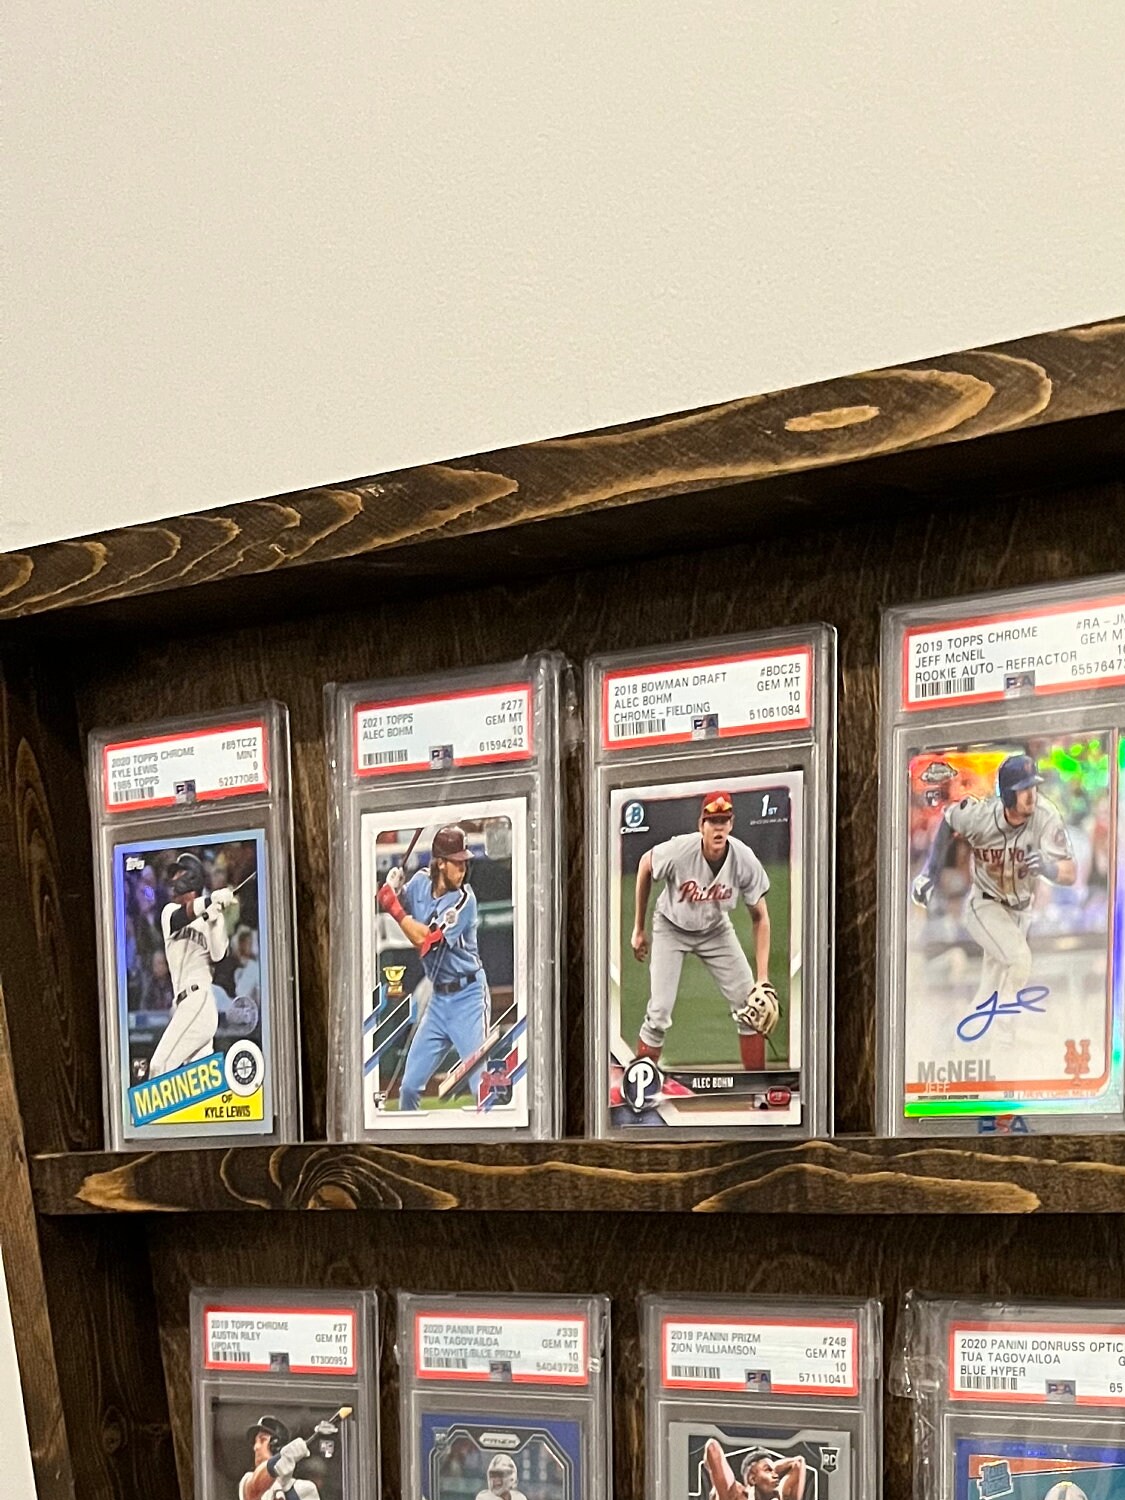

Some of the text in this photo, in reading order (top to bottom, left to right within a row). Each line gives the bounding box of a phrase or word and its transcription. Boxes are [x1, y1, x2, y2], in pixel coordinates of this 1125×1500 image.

[916, 627, 1038, 654] 2019 TOPPS CHROME
[1081, 632, 1107, 645] GEM
[916, 650, 985, 668] JEFF McNEIL
[760, 663, 800, 677] #BDC25
[916, 651, 1077, 682] ROOKIE AUTO REFRACTOR
[615, 672, 727, 696] 2018 BOWMAN DRAFT
[757, 677, 800, 691] GEM MT
[615, 693, 672, 709] ALEC BOHM
[789, 692, 800, 702] 10
[501, 700, 522, 711] #277
[614, 702, 710, 723] CHROME FIELDING
[363, 713, 413, 728] 2021 TOPPS
[486, 713, 522, 726] GEM MT
[363, 726, 413, 740] ALEC BOHM
[513, 725, 523, 735] 10
[133, 752, 158, 763] TOPPS
[112, 764, 158, 779] KYLE LEWIS
[135, 776, 159, 788] TOPPS
[678, 880, 732, 902] Phillies
[918, 1059, 996, 1083] McNEIL
[134, 1060, 222, 1117] MARINERS
[692, 1077, 733, 1088] ALEC BOHM
[925, 1083, 949, 1093] JEFF
[205, 1106, 250, 1118] KYLE LEWIS
[446, 1324, 474, 1335] PANINI
[315, 1334, 347, 1343] GEM MT
[424, 1335, 440, 1345] TUA
[697, 1332, 761, 1343] PANINI PRIZM
[339, 1346, 347, 1354] 10
[541, 1340, 578, 1349] GEM MT
[671, 1343, 757, 1356] ZION WILLIAMSON
[961, 1339, 1124, 1353] 2020 PANINI DONRUSS OPTIC
[569, 1352, 578, 1361] 10
[806, 1348, 846, 1359] GEM MT
[961, 1352, 1061, 1364] TUA TAGOVAILOA
[835, 1362, 846, 1373] 10
[961, 1366, 1026, 1377] BLUE HYPER
